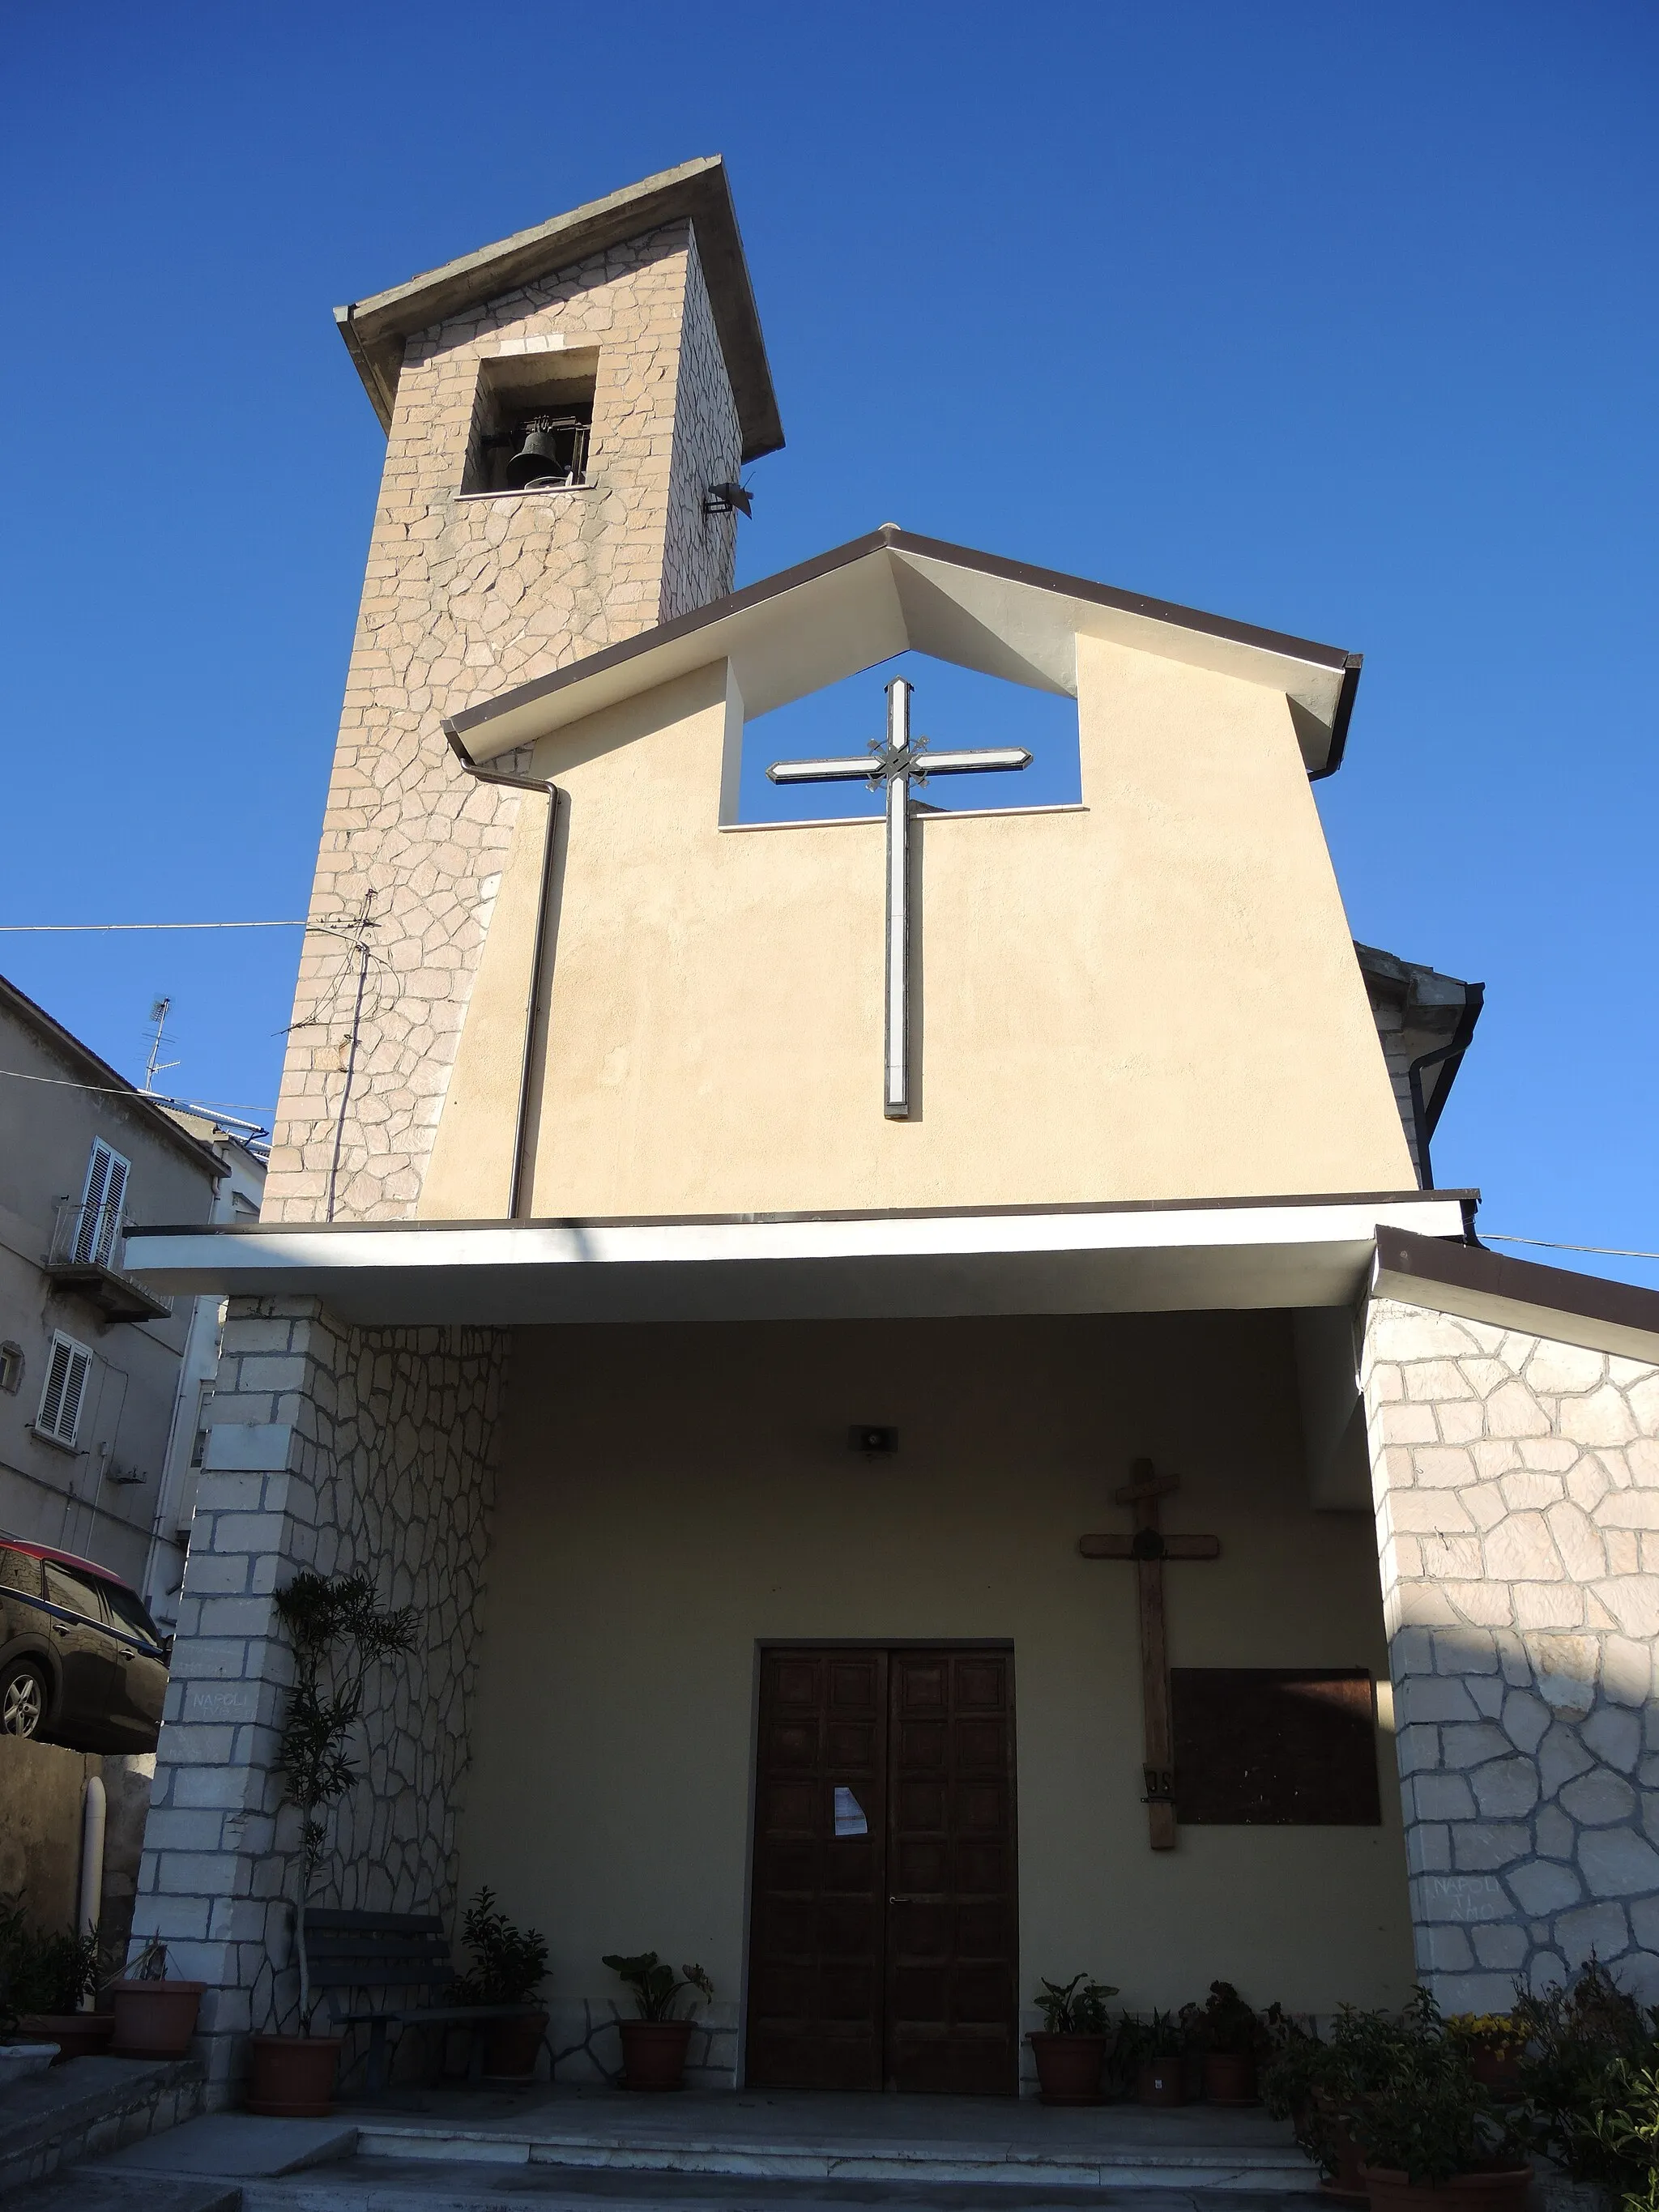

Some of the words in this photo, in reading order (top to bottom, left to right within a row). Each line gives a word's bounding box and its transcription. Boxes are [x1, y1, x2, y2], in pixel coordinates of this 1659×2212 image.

[193, 1693, 247, 1707] NAPOLI
[1433, 1876, 1500, 1895] NAPOLI
[1452, 1893, 1472, 1908] TI
[1449, 1903, 1495, 1922] AMO
